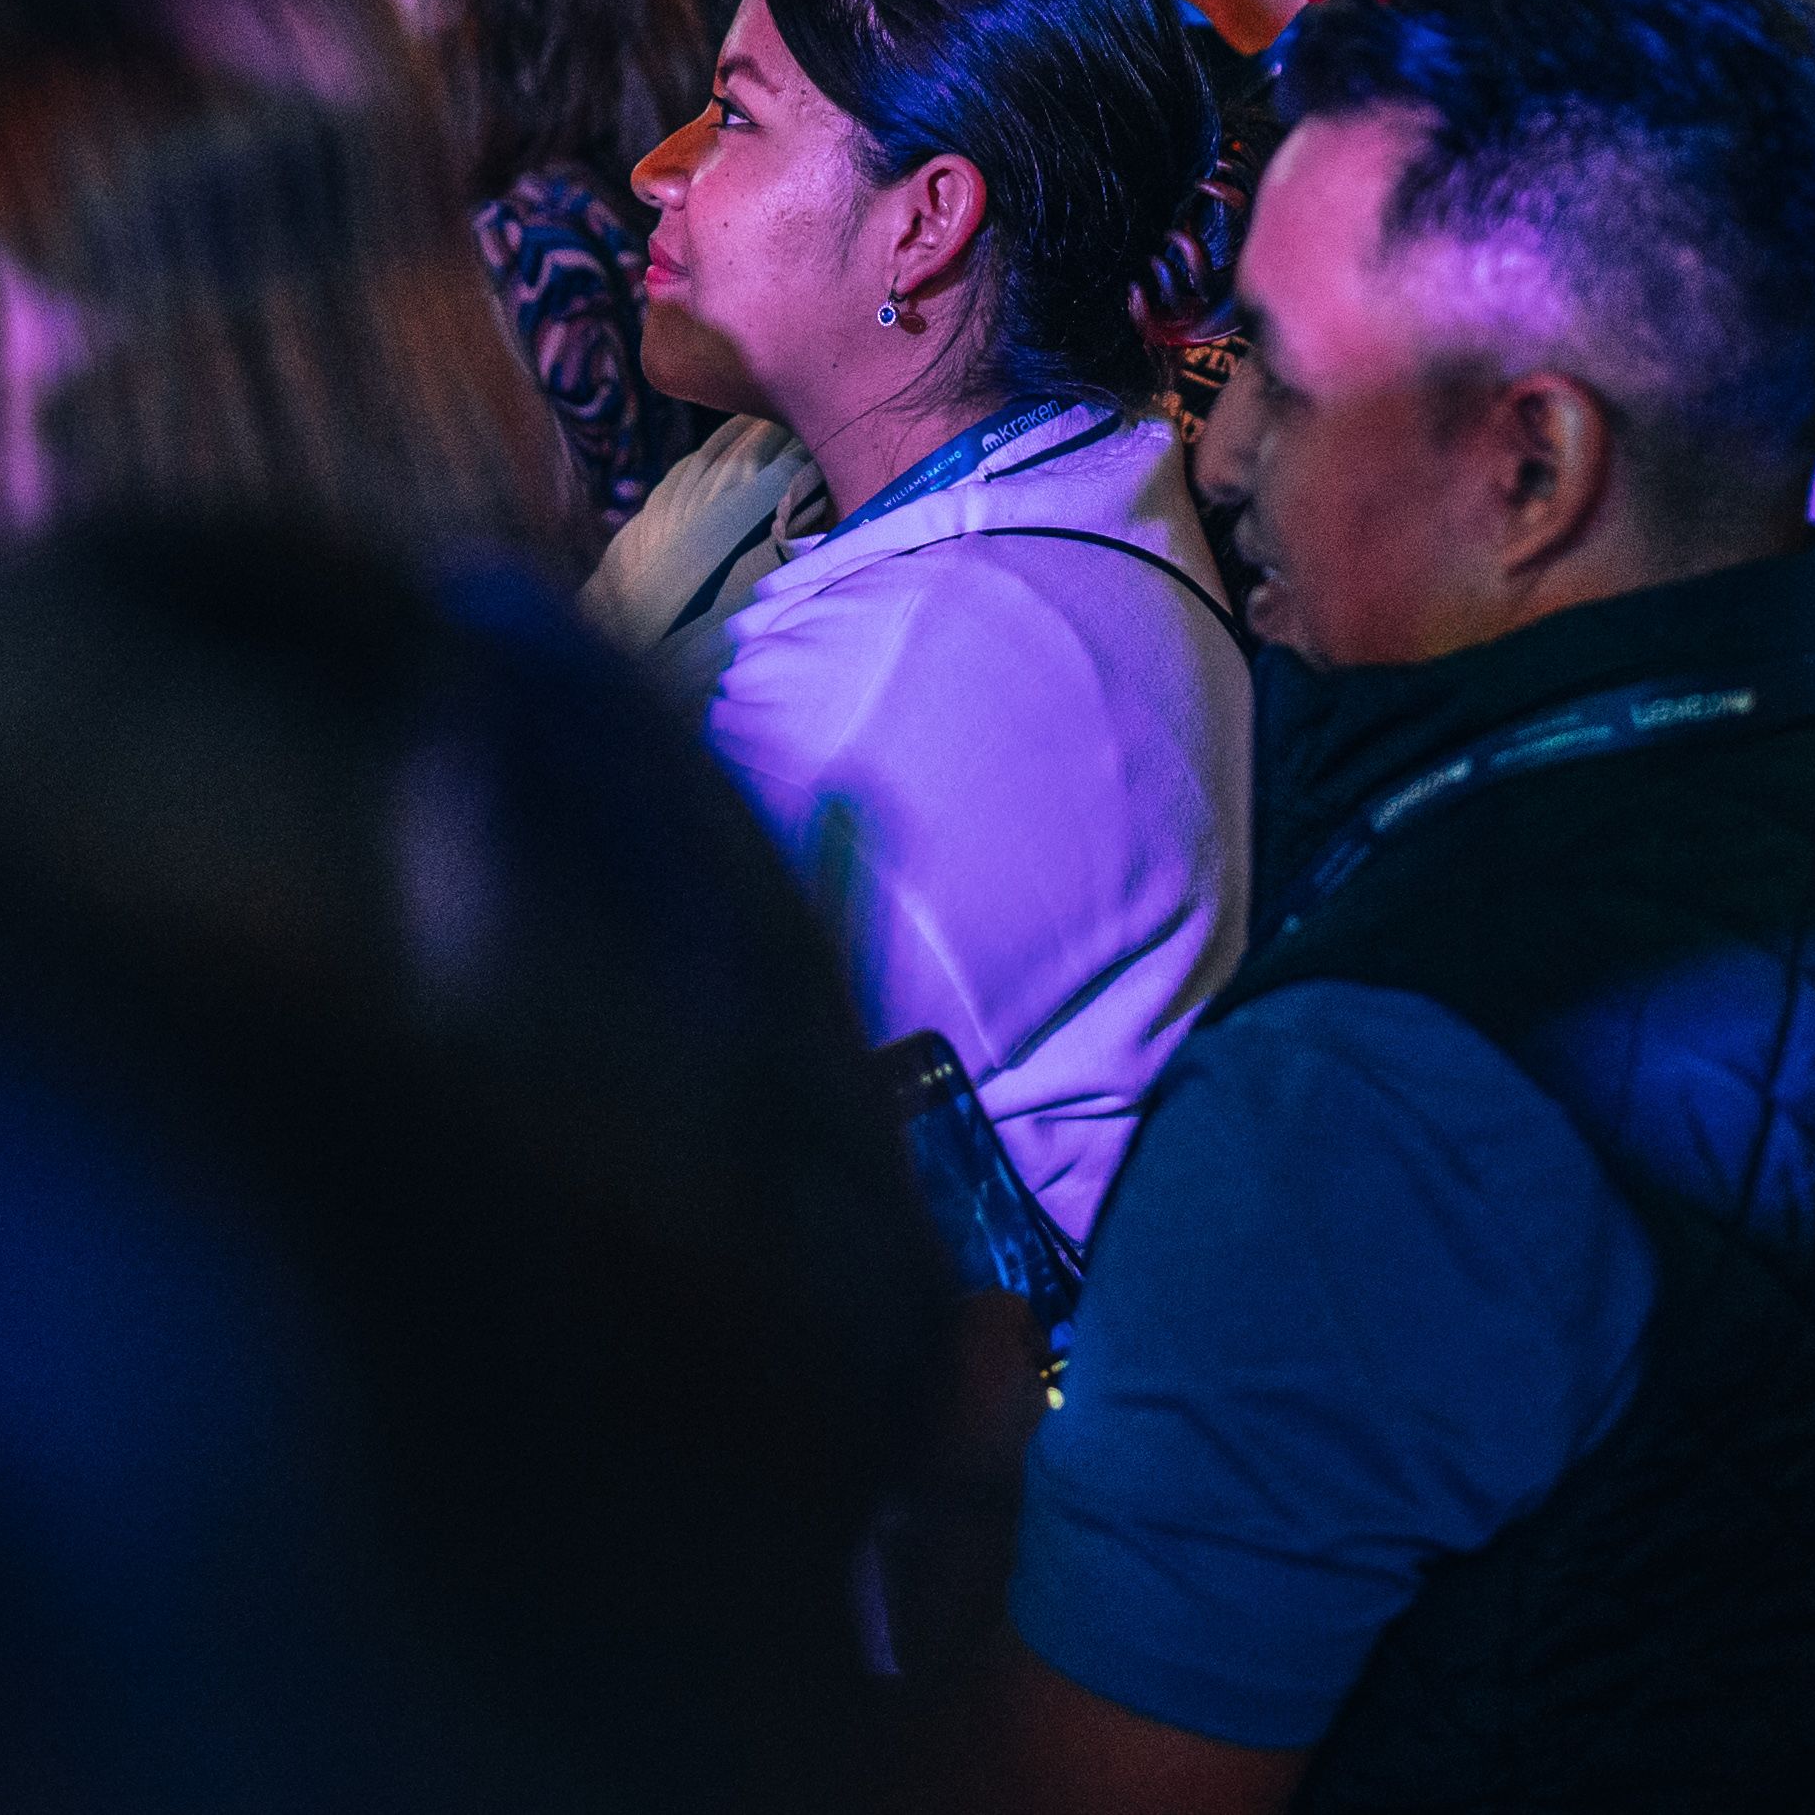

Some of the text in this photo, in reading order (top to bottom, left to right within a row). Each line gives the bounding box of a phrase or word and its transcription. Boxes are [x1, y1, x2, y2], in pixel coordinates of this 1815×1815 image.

[997, 398, 1062, 442] kraken
[883, 474, 928, 508] WILLIAMS
[925, 450, 962, 478] RACING
